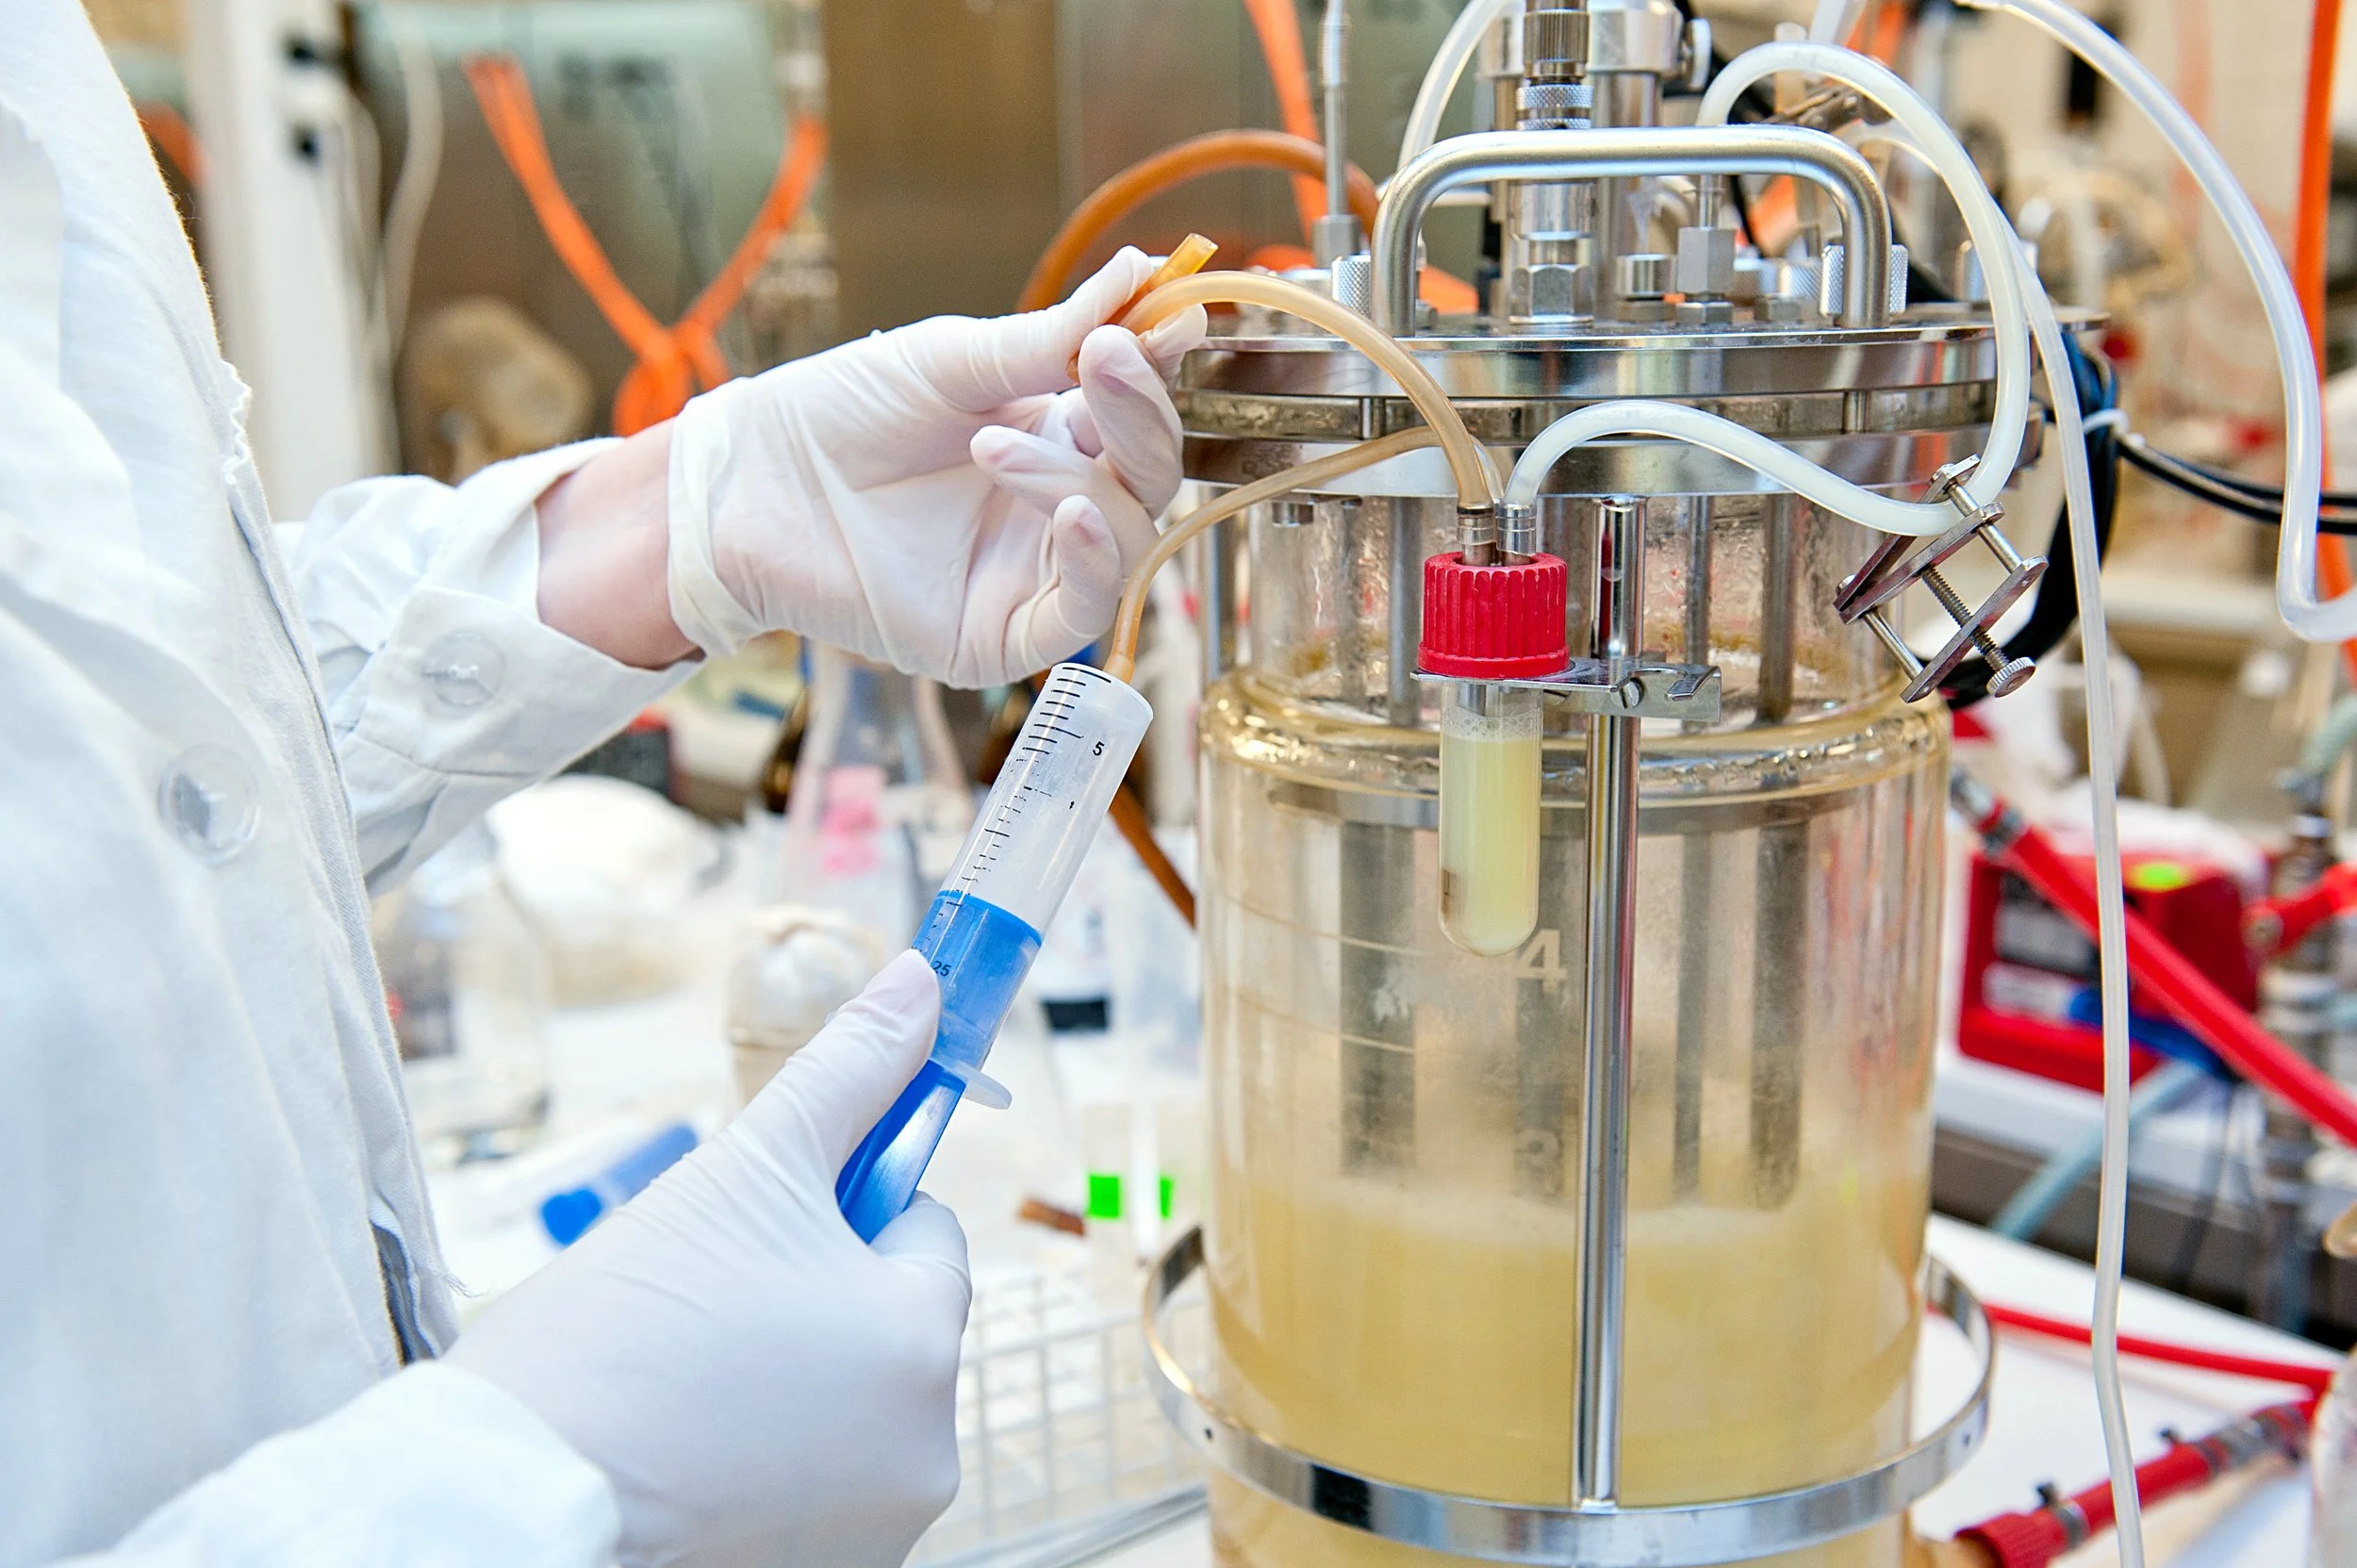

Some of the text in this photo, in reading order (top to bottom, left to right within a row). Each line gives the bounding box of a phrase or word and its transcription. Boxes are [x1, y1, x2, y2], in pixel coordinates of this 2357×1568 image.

[1093, 741, 1105, 756] 5
[933, 960, 951, 977] 25
[1514, 929, 1567, 993] 4
